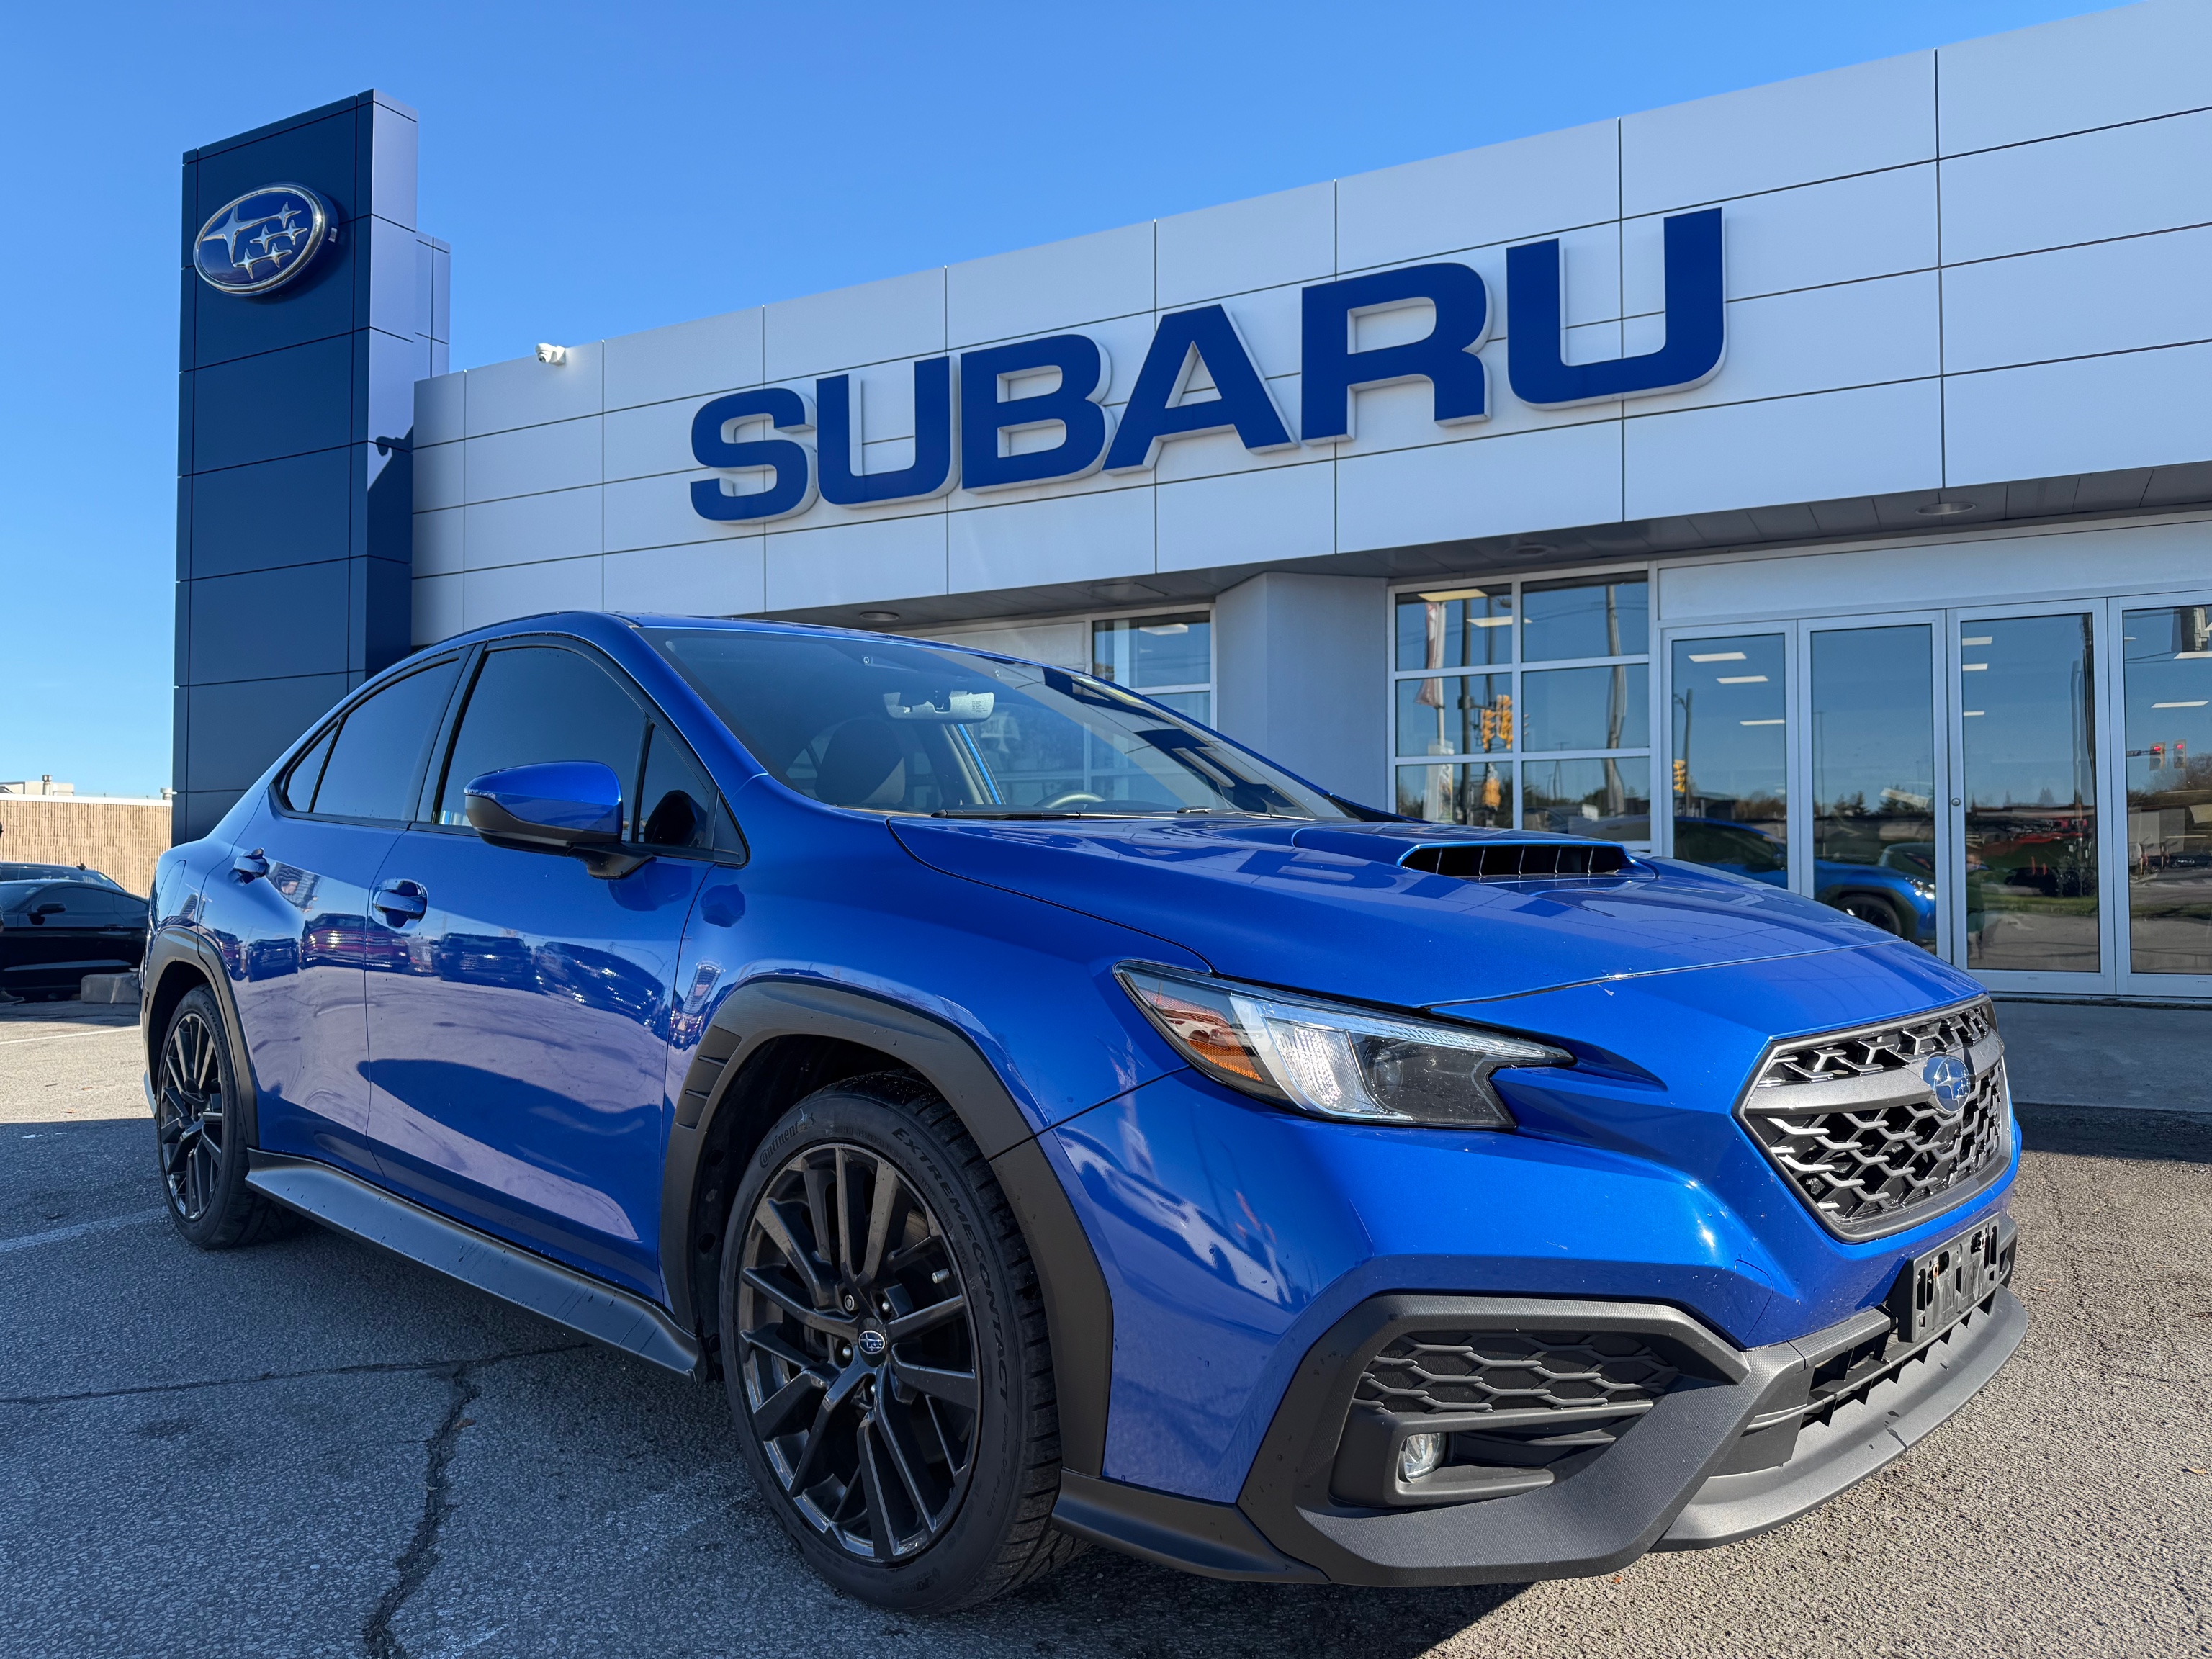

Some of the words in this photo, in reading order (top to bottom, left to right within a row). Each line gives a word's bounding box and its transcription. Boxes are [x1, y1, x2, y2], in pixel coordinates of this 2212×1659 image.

[690, 207, 1725, 523] SUBARU
[760, 1117, 807, 1168] Continent
[891, 1127, 1008, 1408] EXTREMECONTACT
[987, 1476, 1001, 1517] PLUS
